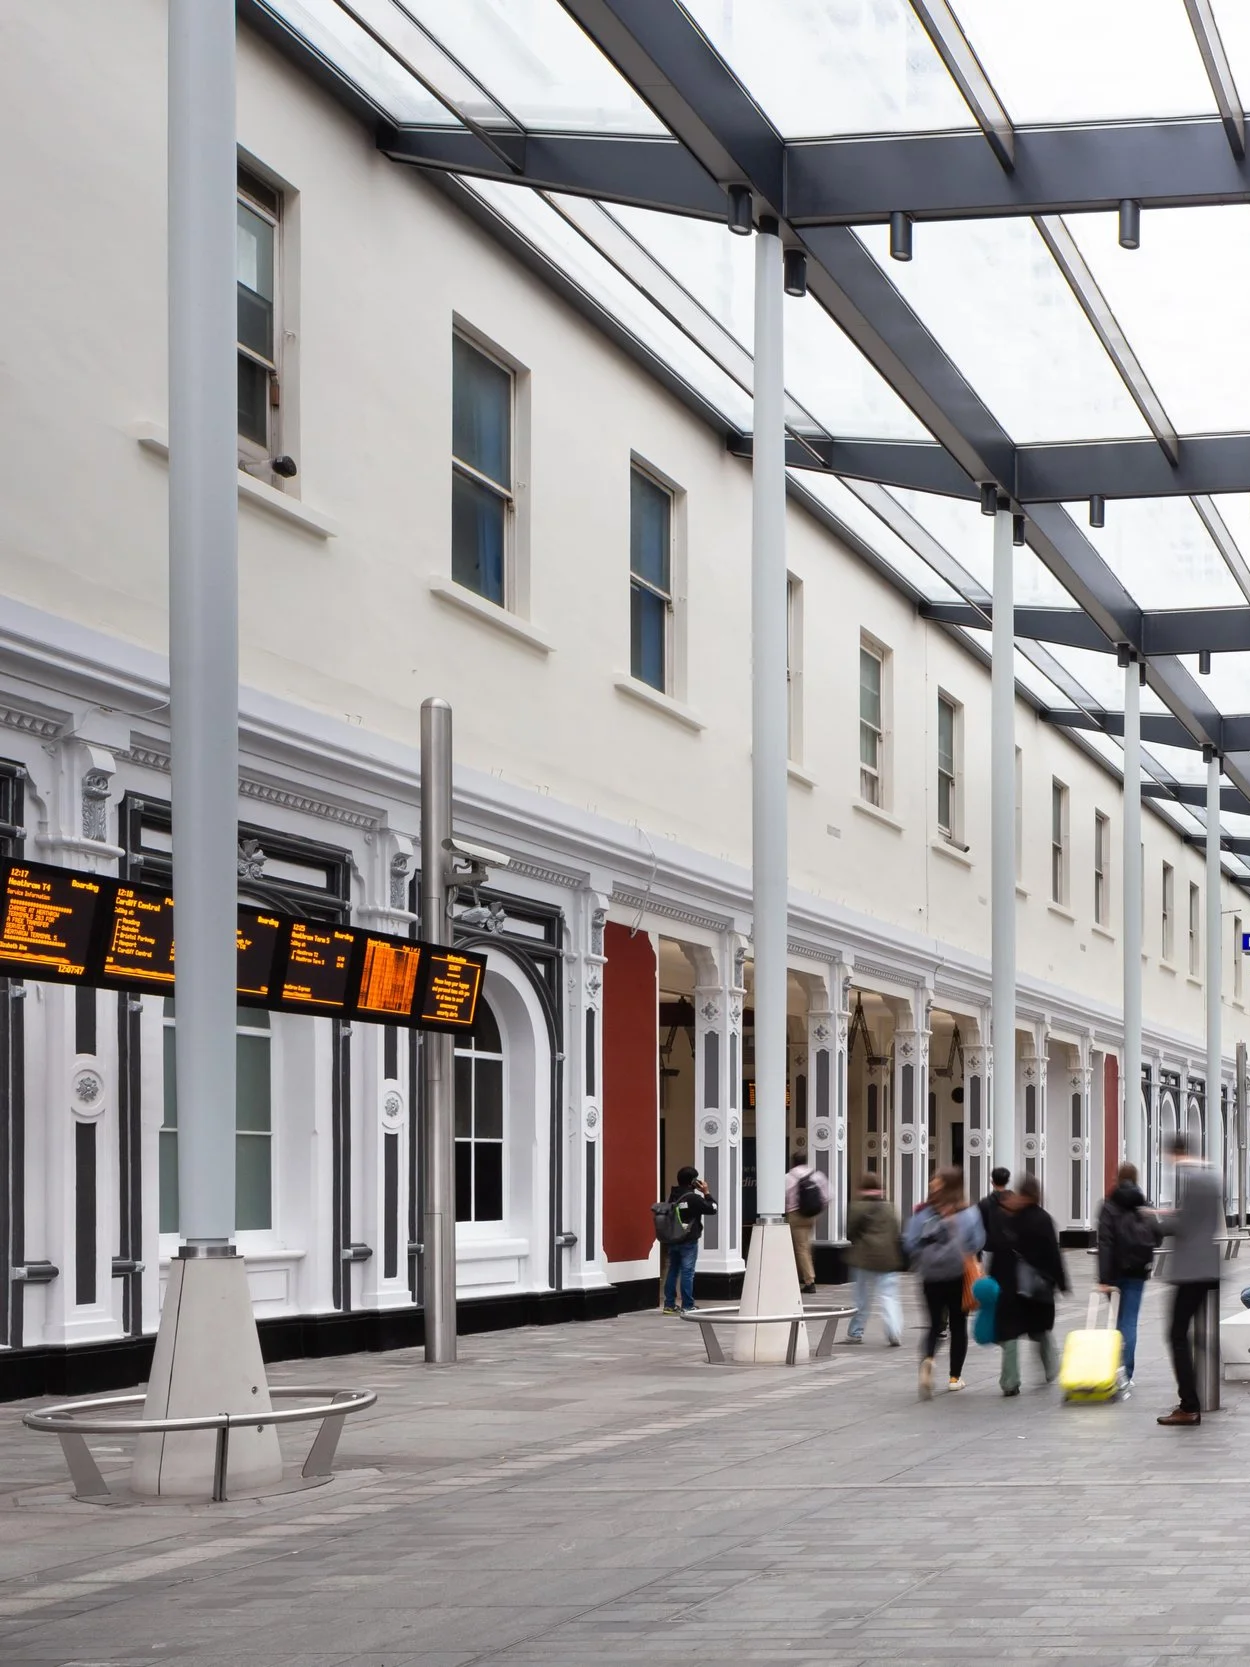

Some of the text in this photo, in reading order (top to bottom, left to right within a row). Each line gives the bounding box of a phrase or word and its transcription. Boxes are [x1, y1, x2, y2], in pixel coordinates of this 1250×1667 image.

[11, 868, 29, 878] 12:17
[42, 882, 51, 892] T4
[72, 880, 100, 893] Boarding
[7, 888, 50, 900] Service Information
[116, 897, 160, 912] Cardiff Central
[258, 916, 279, 928] Boarding
[120, 932, 155, 944] Bristol Parkway
[314, 934, 326, 943] Term
[334, 931, 354, 942] Boarding
[135, 950, 152, 958] Central
